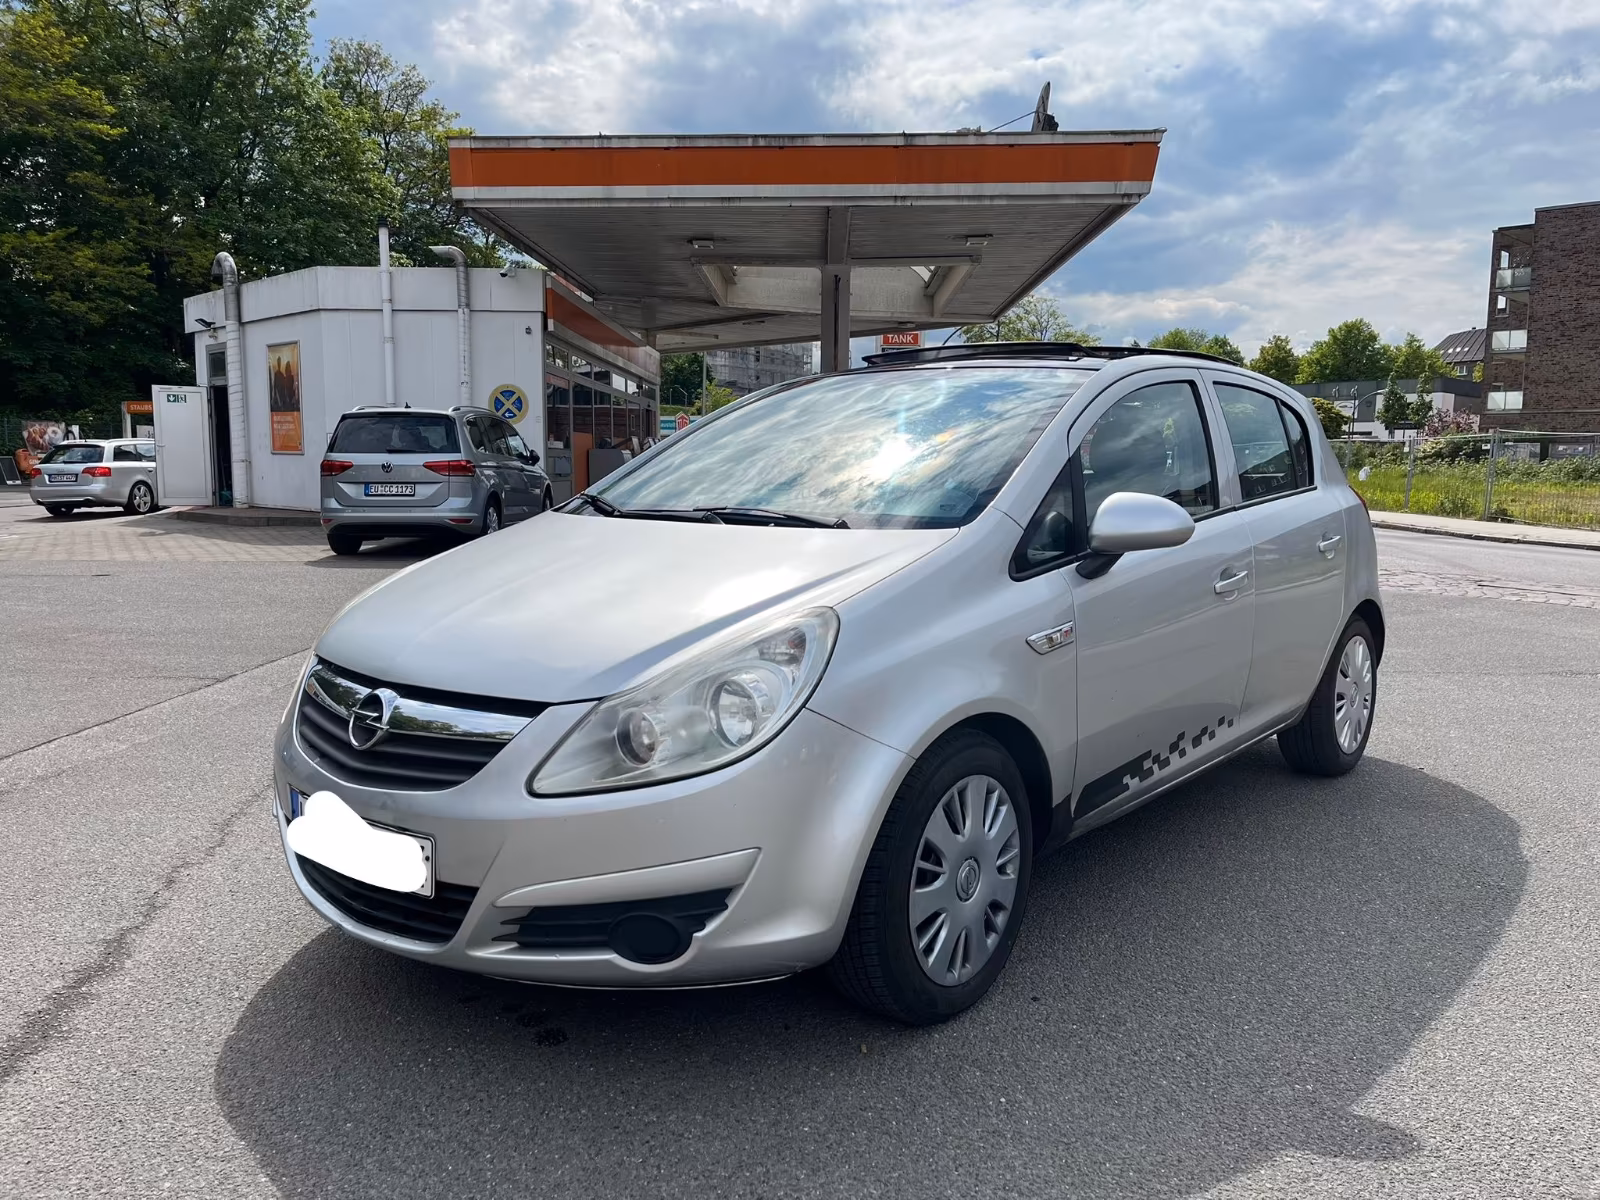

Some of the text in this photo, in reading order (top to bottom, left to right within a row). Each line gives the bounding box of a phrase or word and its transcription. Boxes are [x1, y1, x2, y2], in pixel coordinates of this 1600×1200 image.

[887, 334, 914, 344] TANK
[370, 485, 414, 493] EU CC 1173
